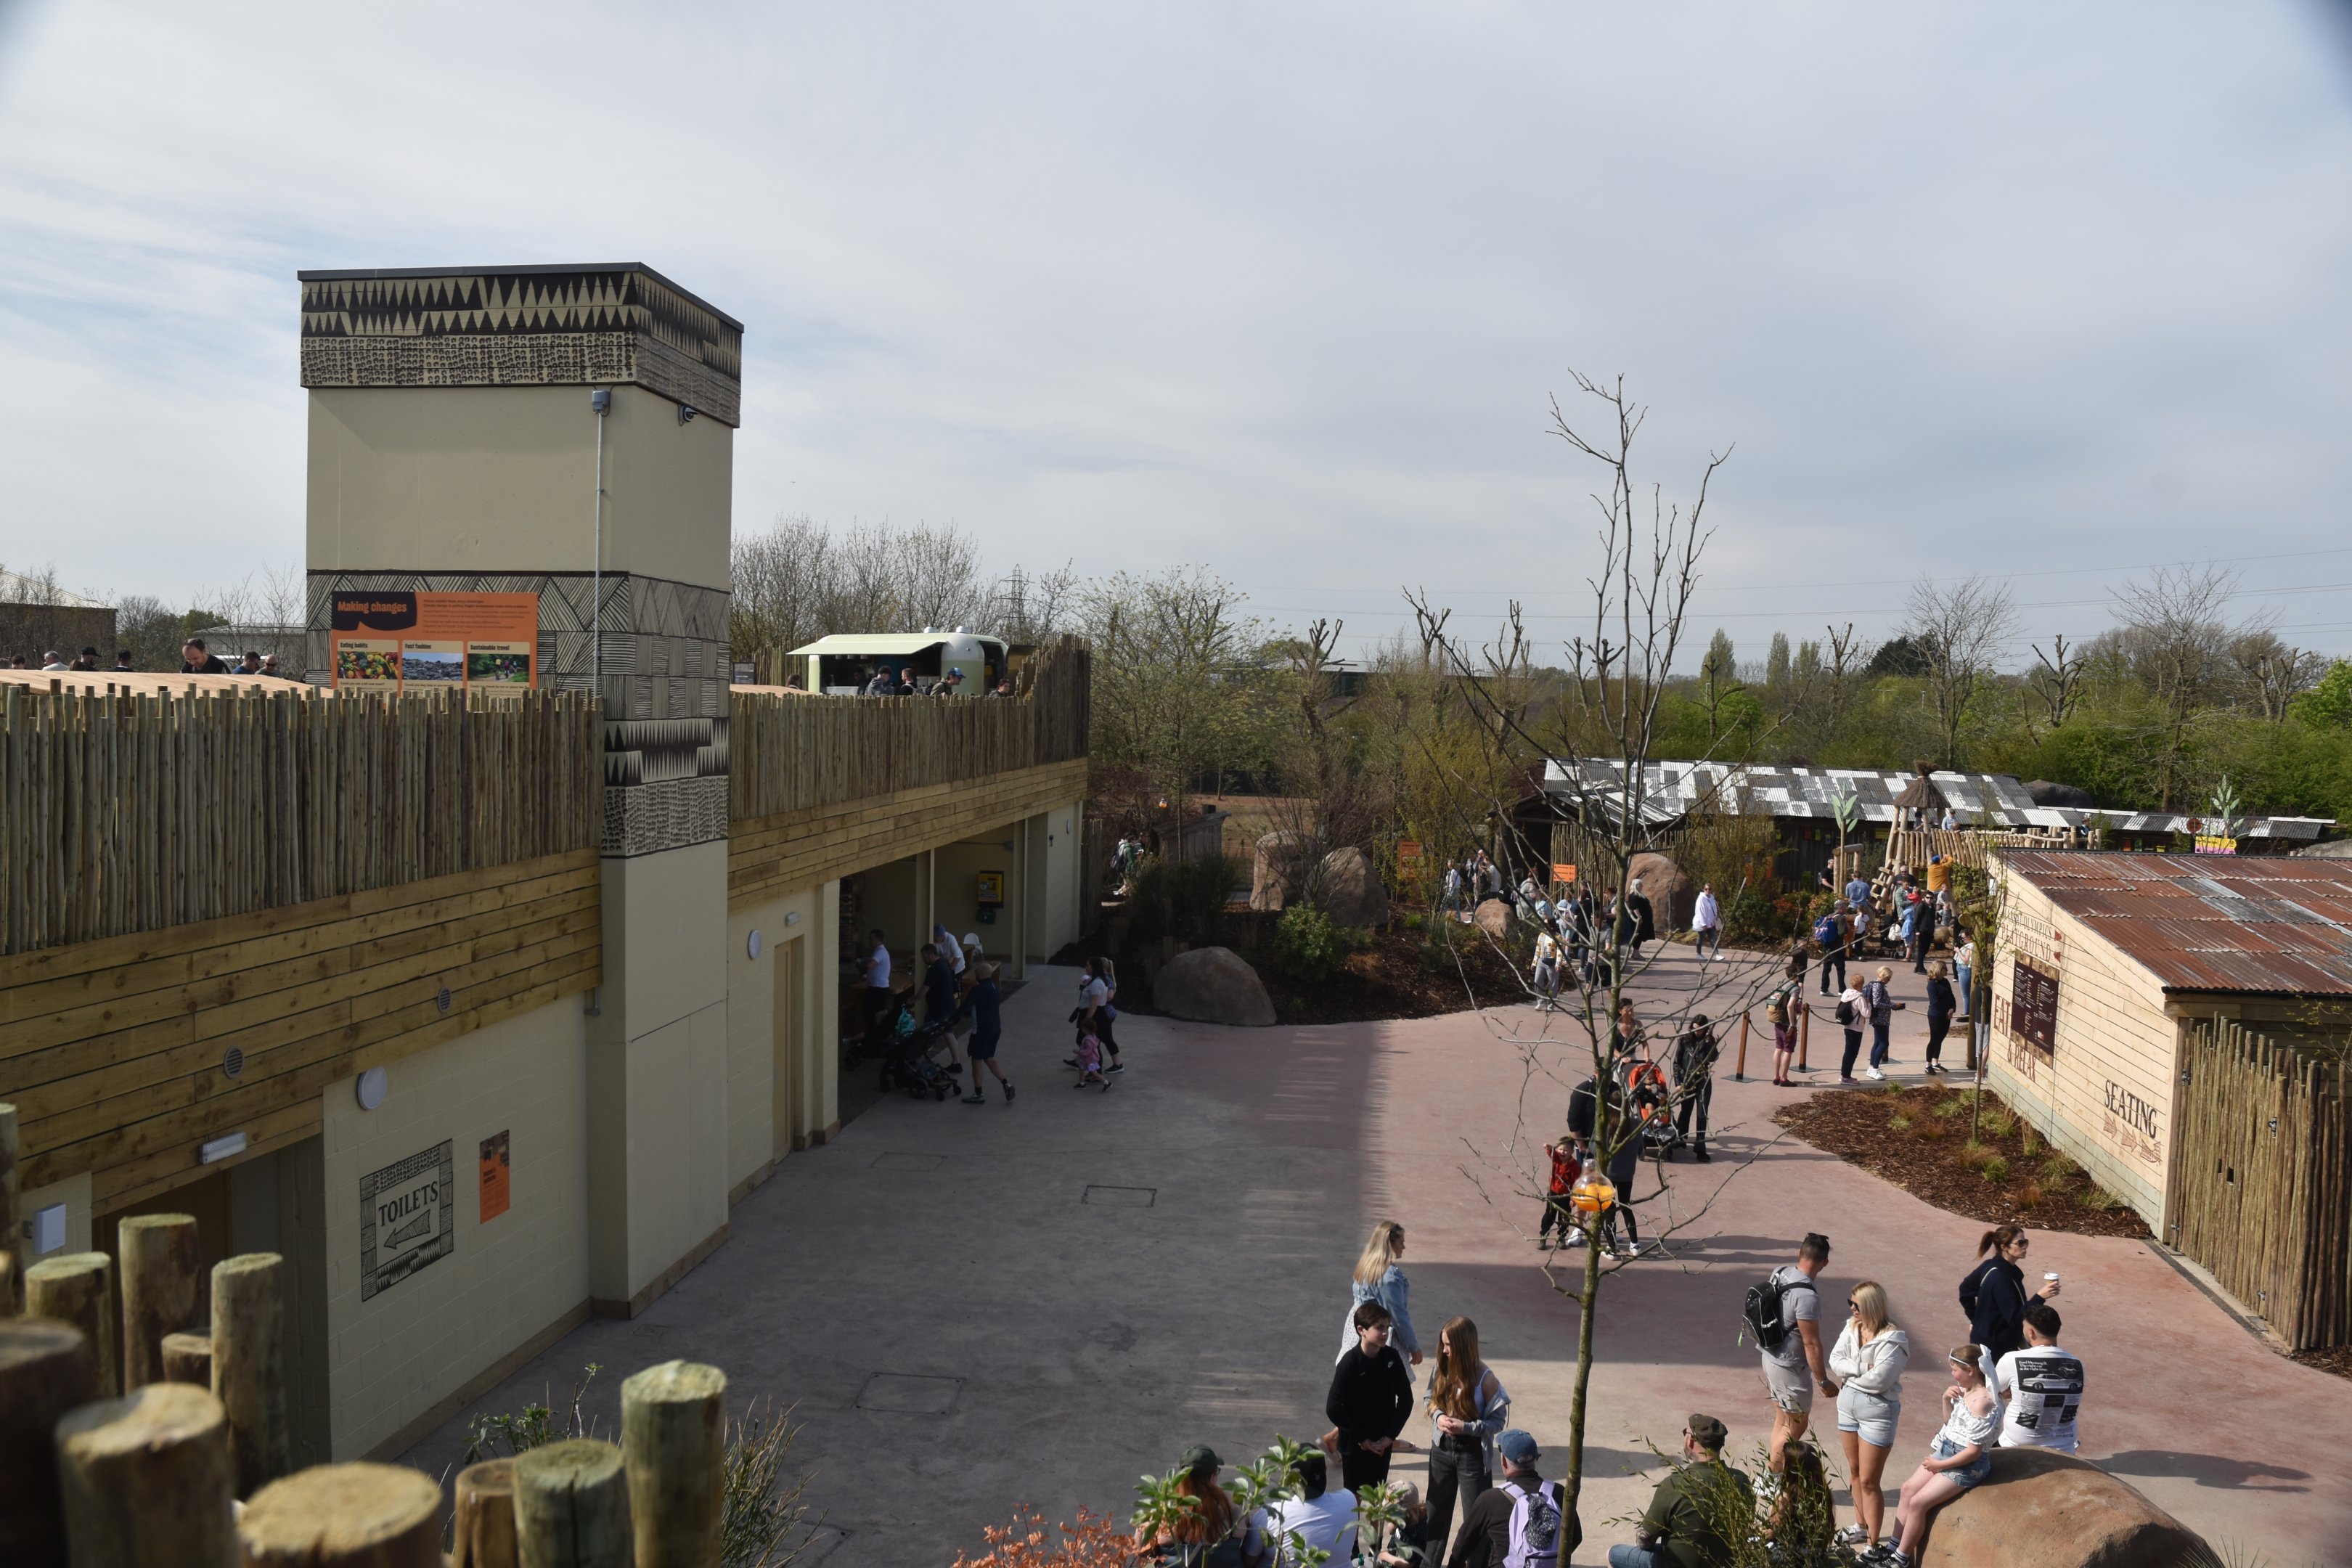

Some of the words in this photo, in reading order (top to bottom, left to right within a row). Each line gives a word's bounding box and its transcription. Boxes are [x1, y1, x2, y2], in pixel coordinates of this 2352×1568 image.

[338, 600, 369, 614] Making
[371, 600, 407, 615] changes
[2001, 923, 2051, 962] PLAYGROUND
[2023, 916, 2051, 940] OLYMPICS
[1993, 993, 2011, 1037] EAT
[2014, 1044, 2036, 1082] RELAX
[2104, 1079, 2157, 1139] SEATING
[378, 1180, 438, 1227] TOILETS
